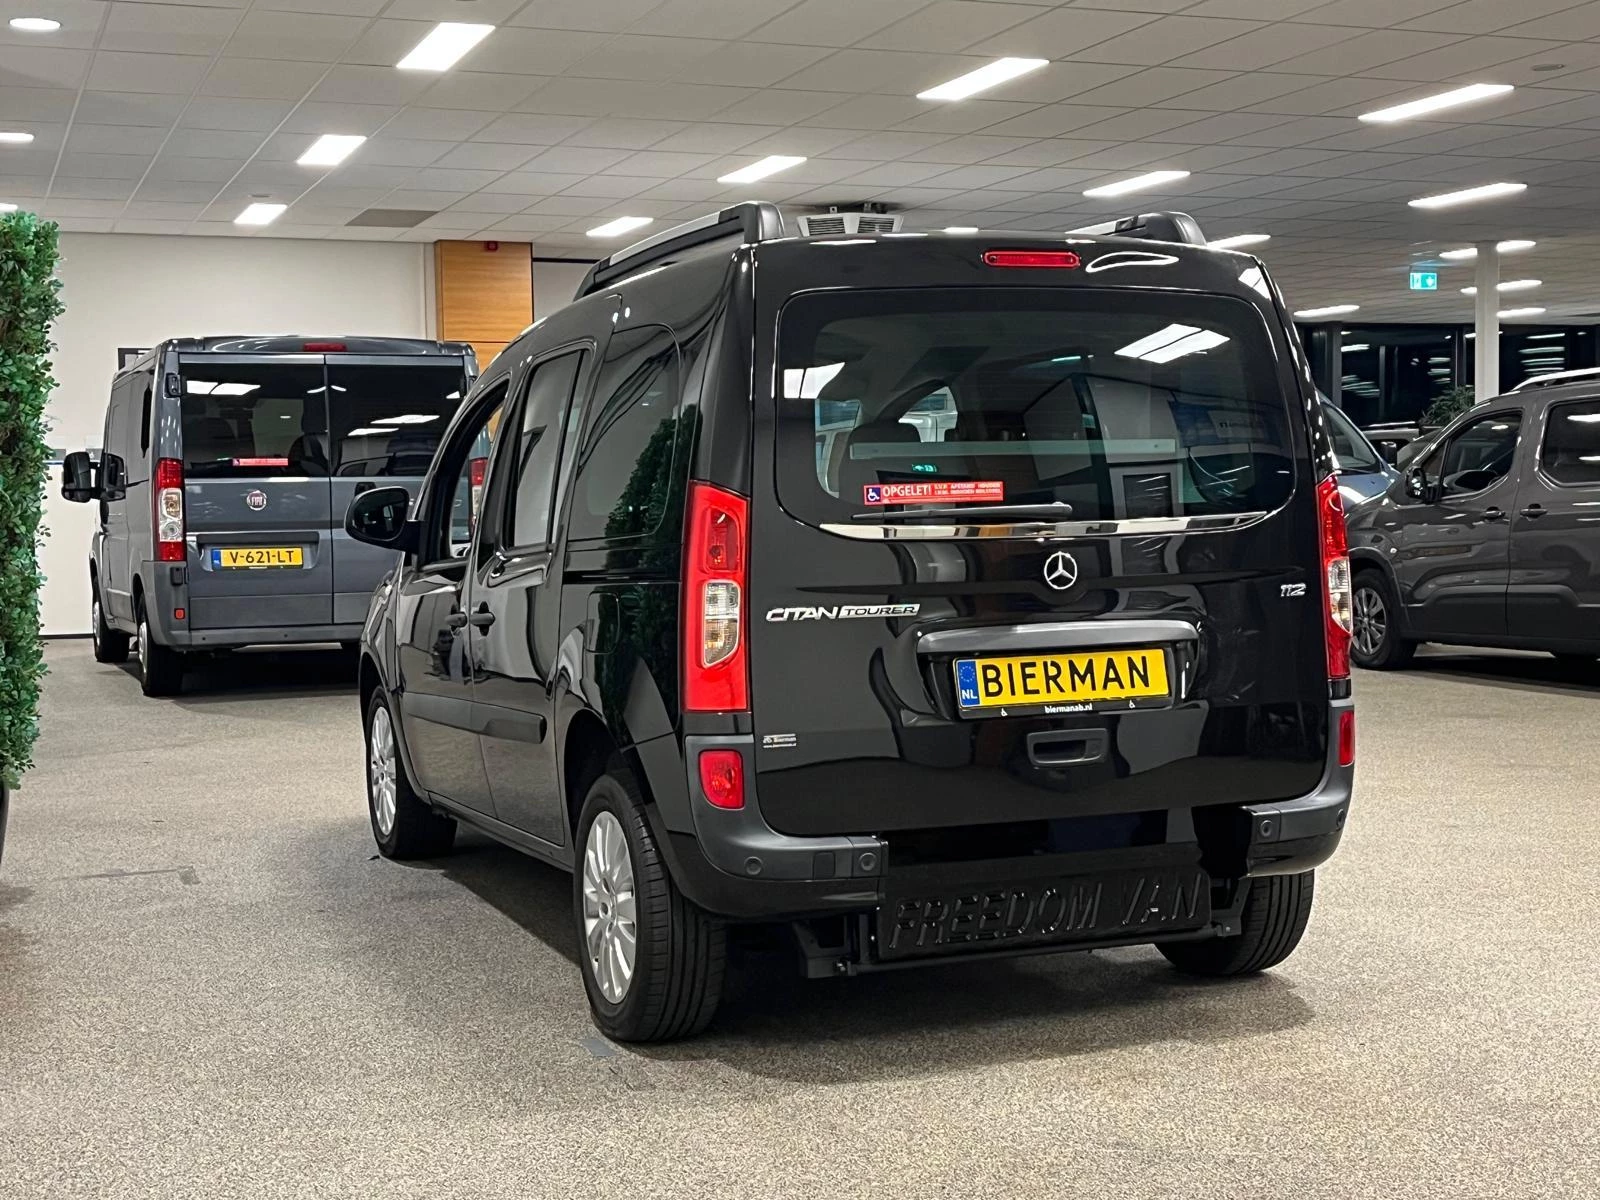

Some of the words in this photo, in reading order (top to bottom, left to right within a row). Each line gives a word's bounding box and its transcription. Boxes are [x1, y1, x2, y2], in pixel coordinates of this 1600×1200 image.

[882, 485, 931, 497] OPGELET!
[229, 551, 294, 564] V-621-LT
[1280, 583, 1306, 597] 112
[765, 606, 839, 622] CITAN
[844, 606, 916, 616] TOURER
[981, 656, 1150, 698] BIERMAN
[961, 688, 978, 699] NL
[1044, 703, 1093, 714] biermanab.nl
[888, 882, 1103, 949] FREEDOM
[1120, 872, 1203, 927] VAN
